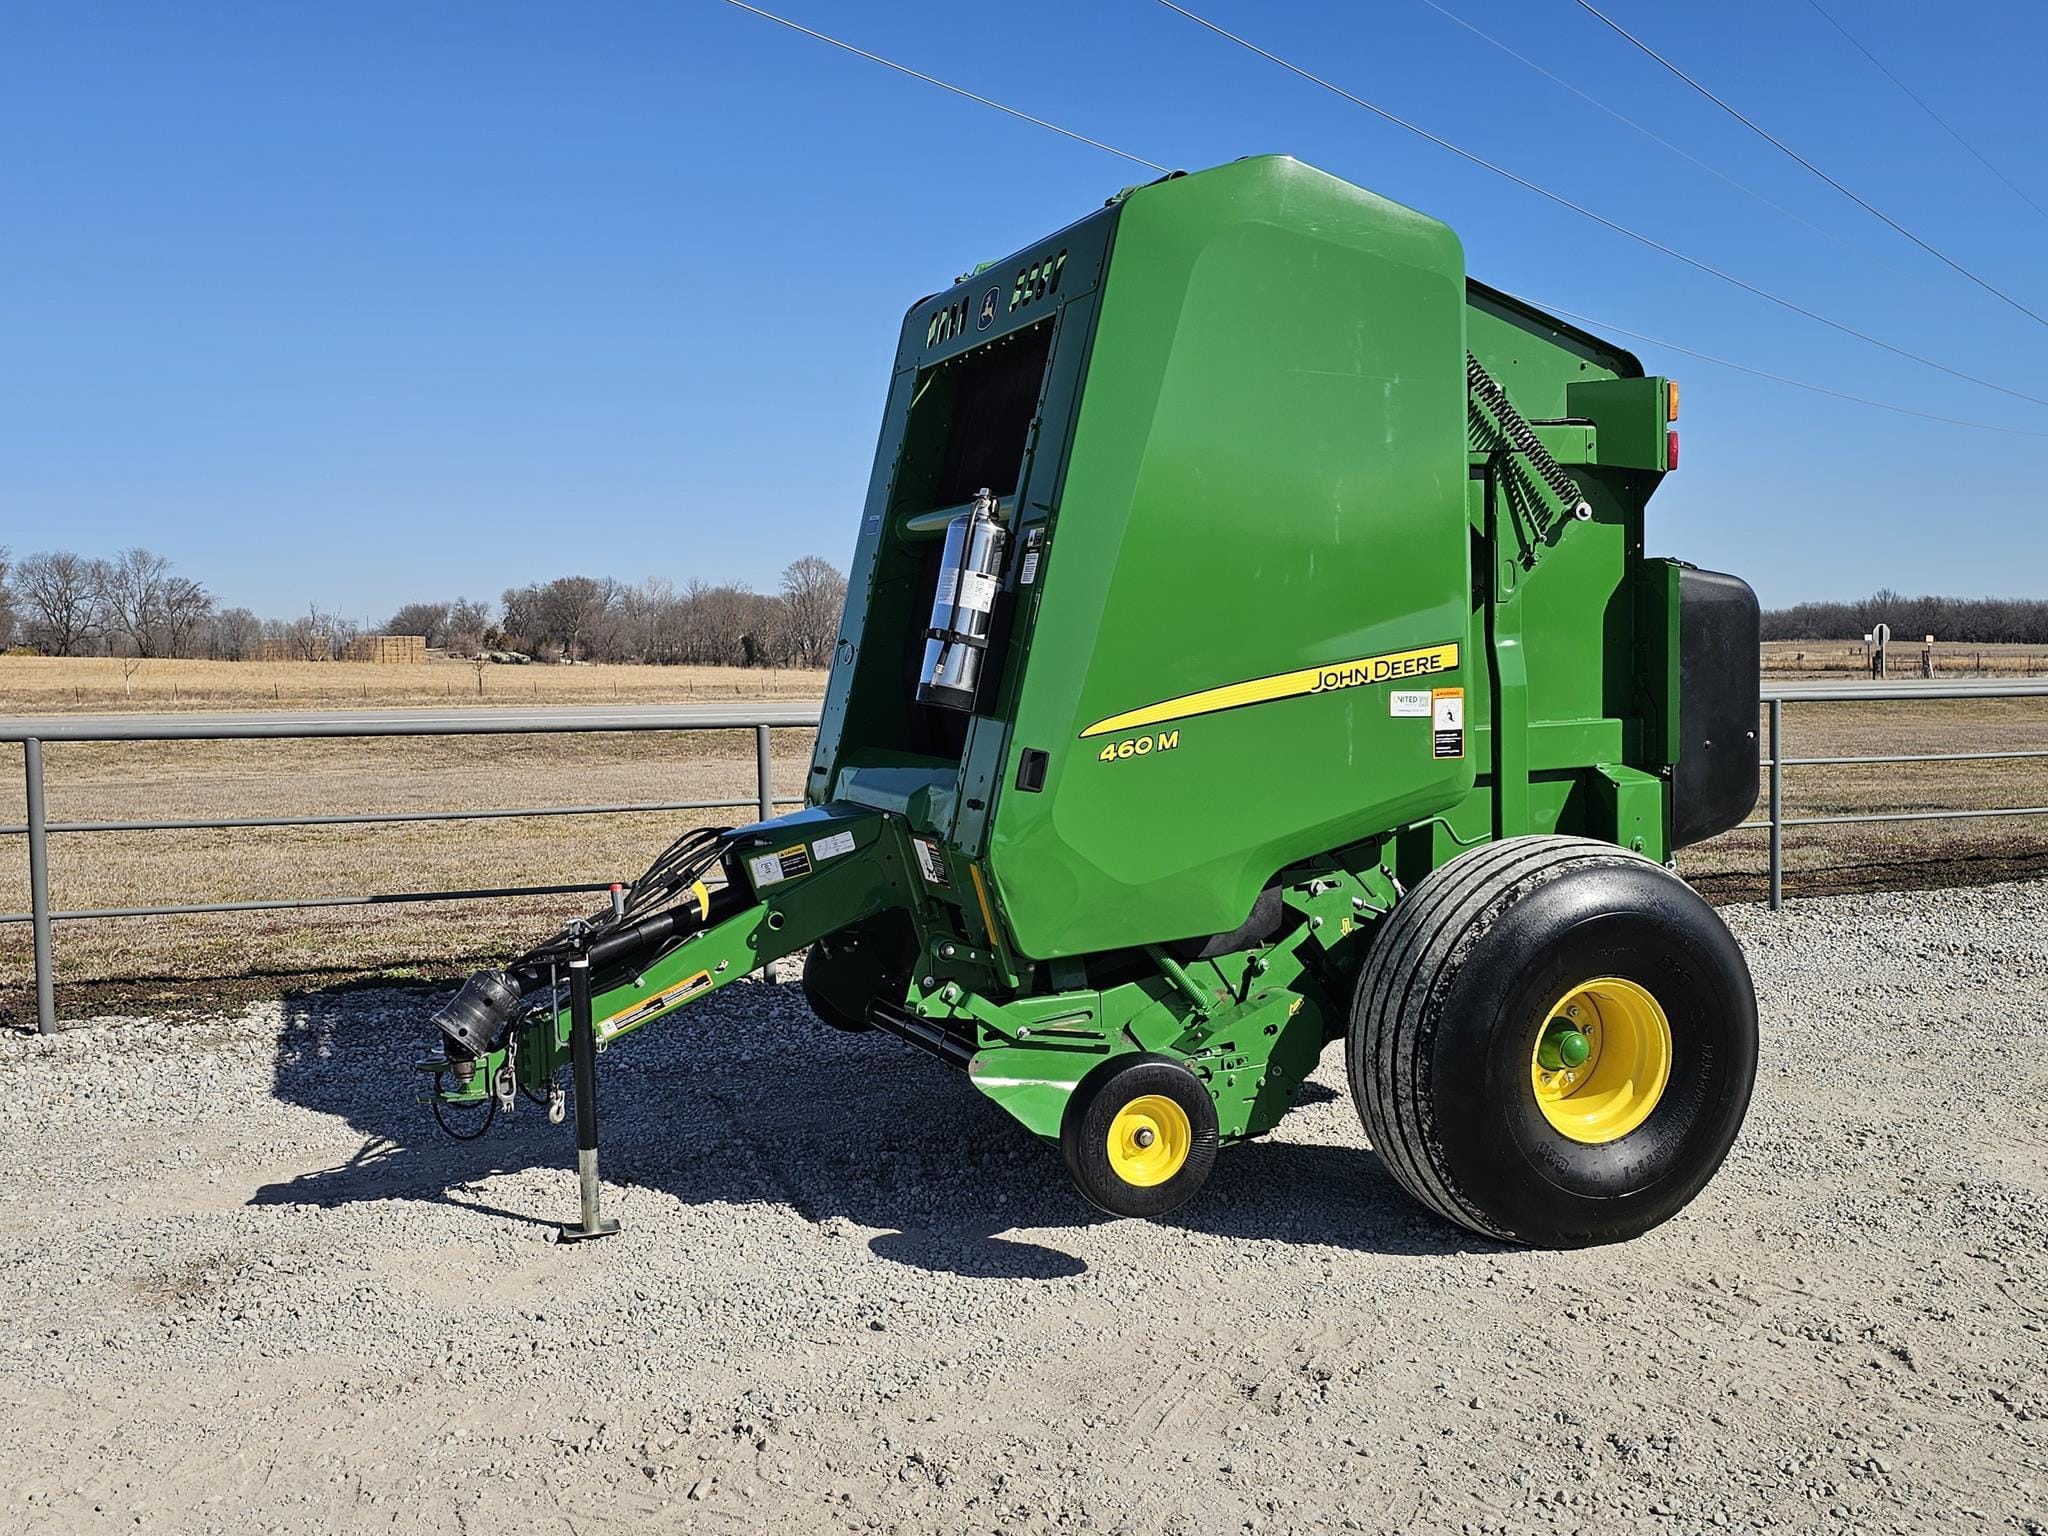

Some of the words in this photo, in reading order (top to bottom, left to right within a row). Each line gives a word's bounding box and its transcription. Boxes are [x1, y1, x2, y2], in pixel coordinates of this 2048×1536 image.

[1312, 667, 1368, 691] JOHN
[1374, 655, 1442, 681] DEERE
[1098, 737, 1153, 763] 460
[1157, 730, 1180, 752] M
